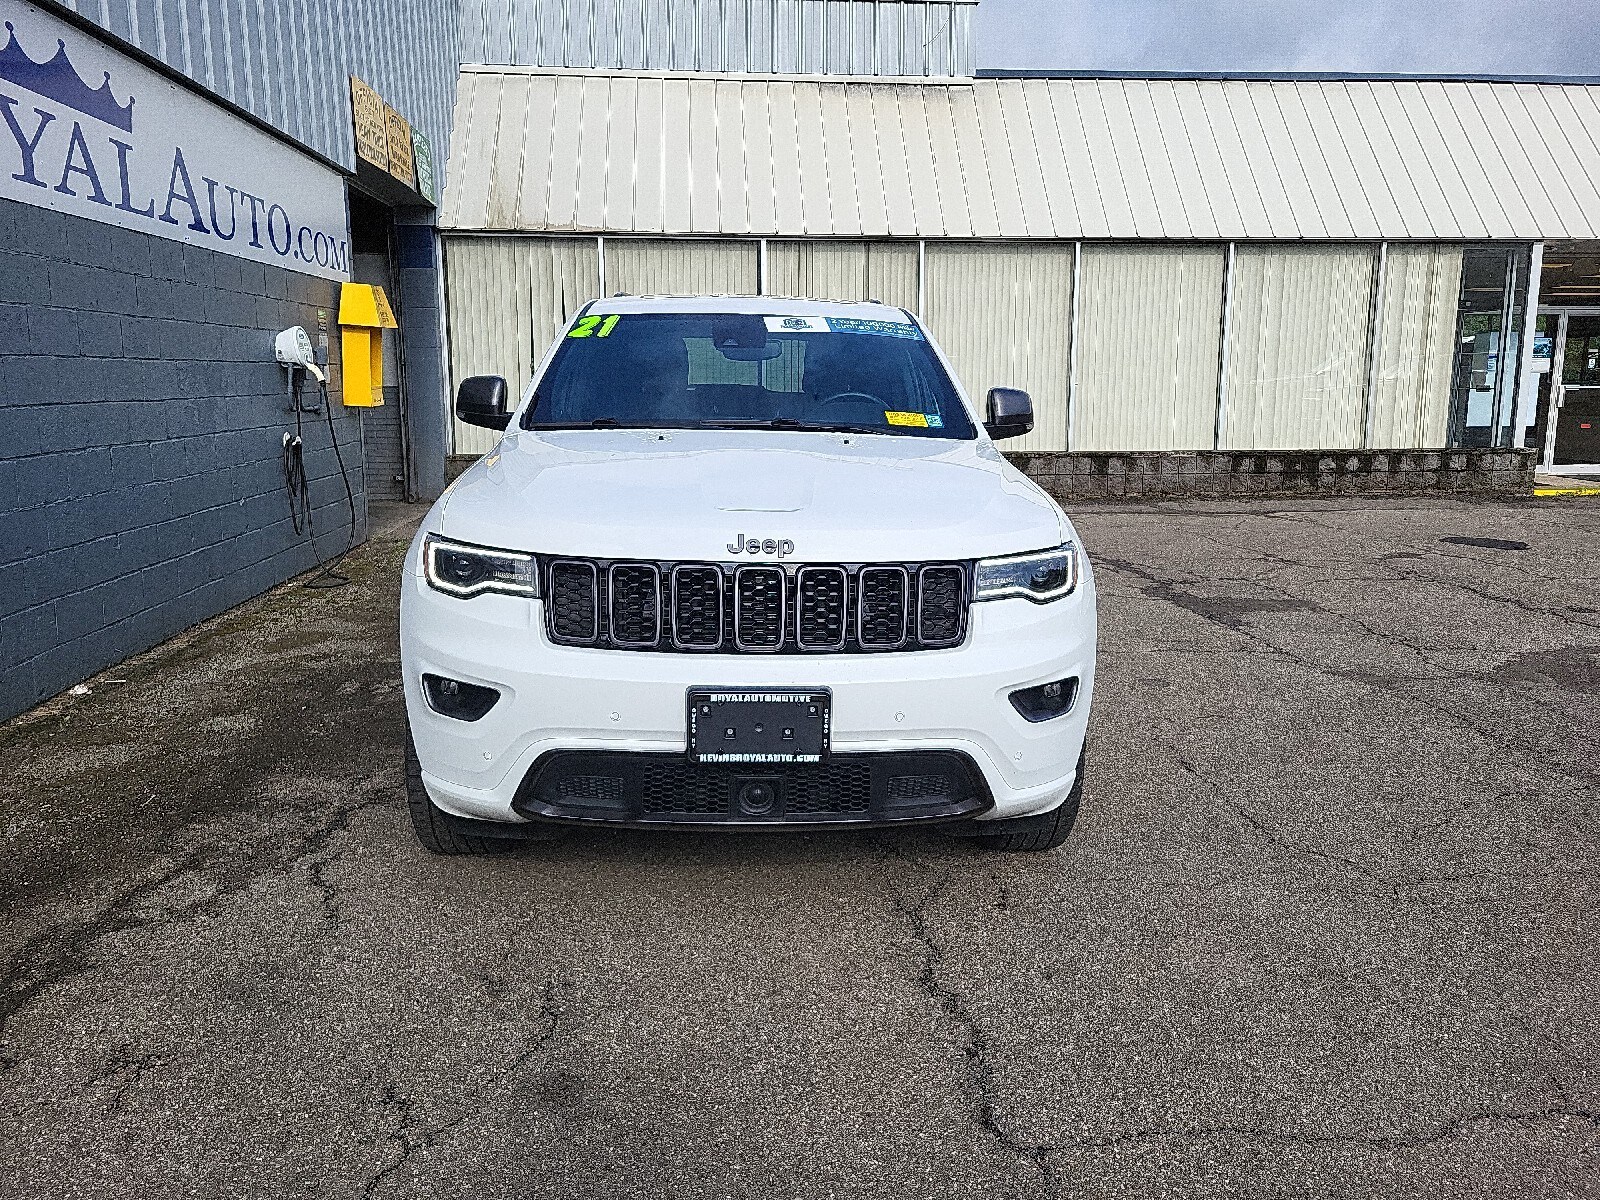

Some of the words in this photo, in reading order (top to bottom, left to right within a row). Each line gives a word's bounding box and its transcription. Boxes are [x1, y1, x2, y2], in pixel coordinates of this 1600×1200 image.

[567, 315, 621, 338] 21
[834, 323, 871, 331] Limited
[872, 325, 918, 338] Warranty
[727, 534, 794, 558] Jeep
